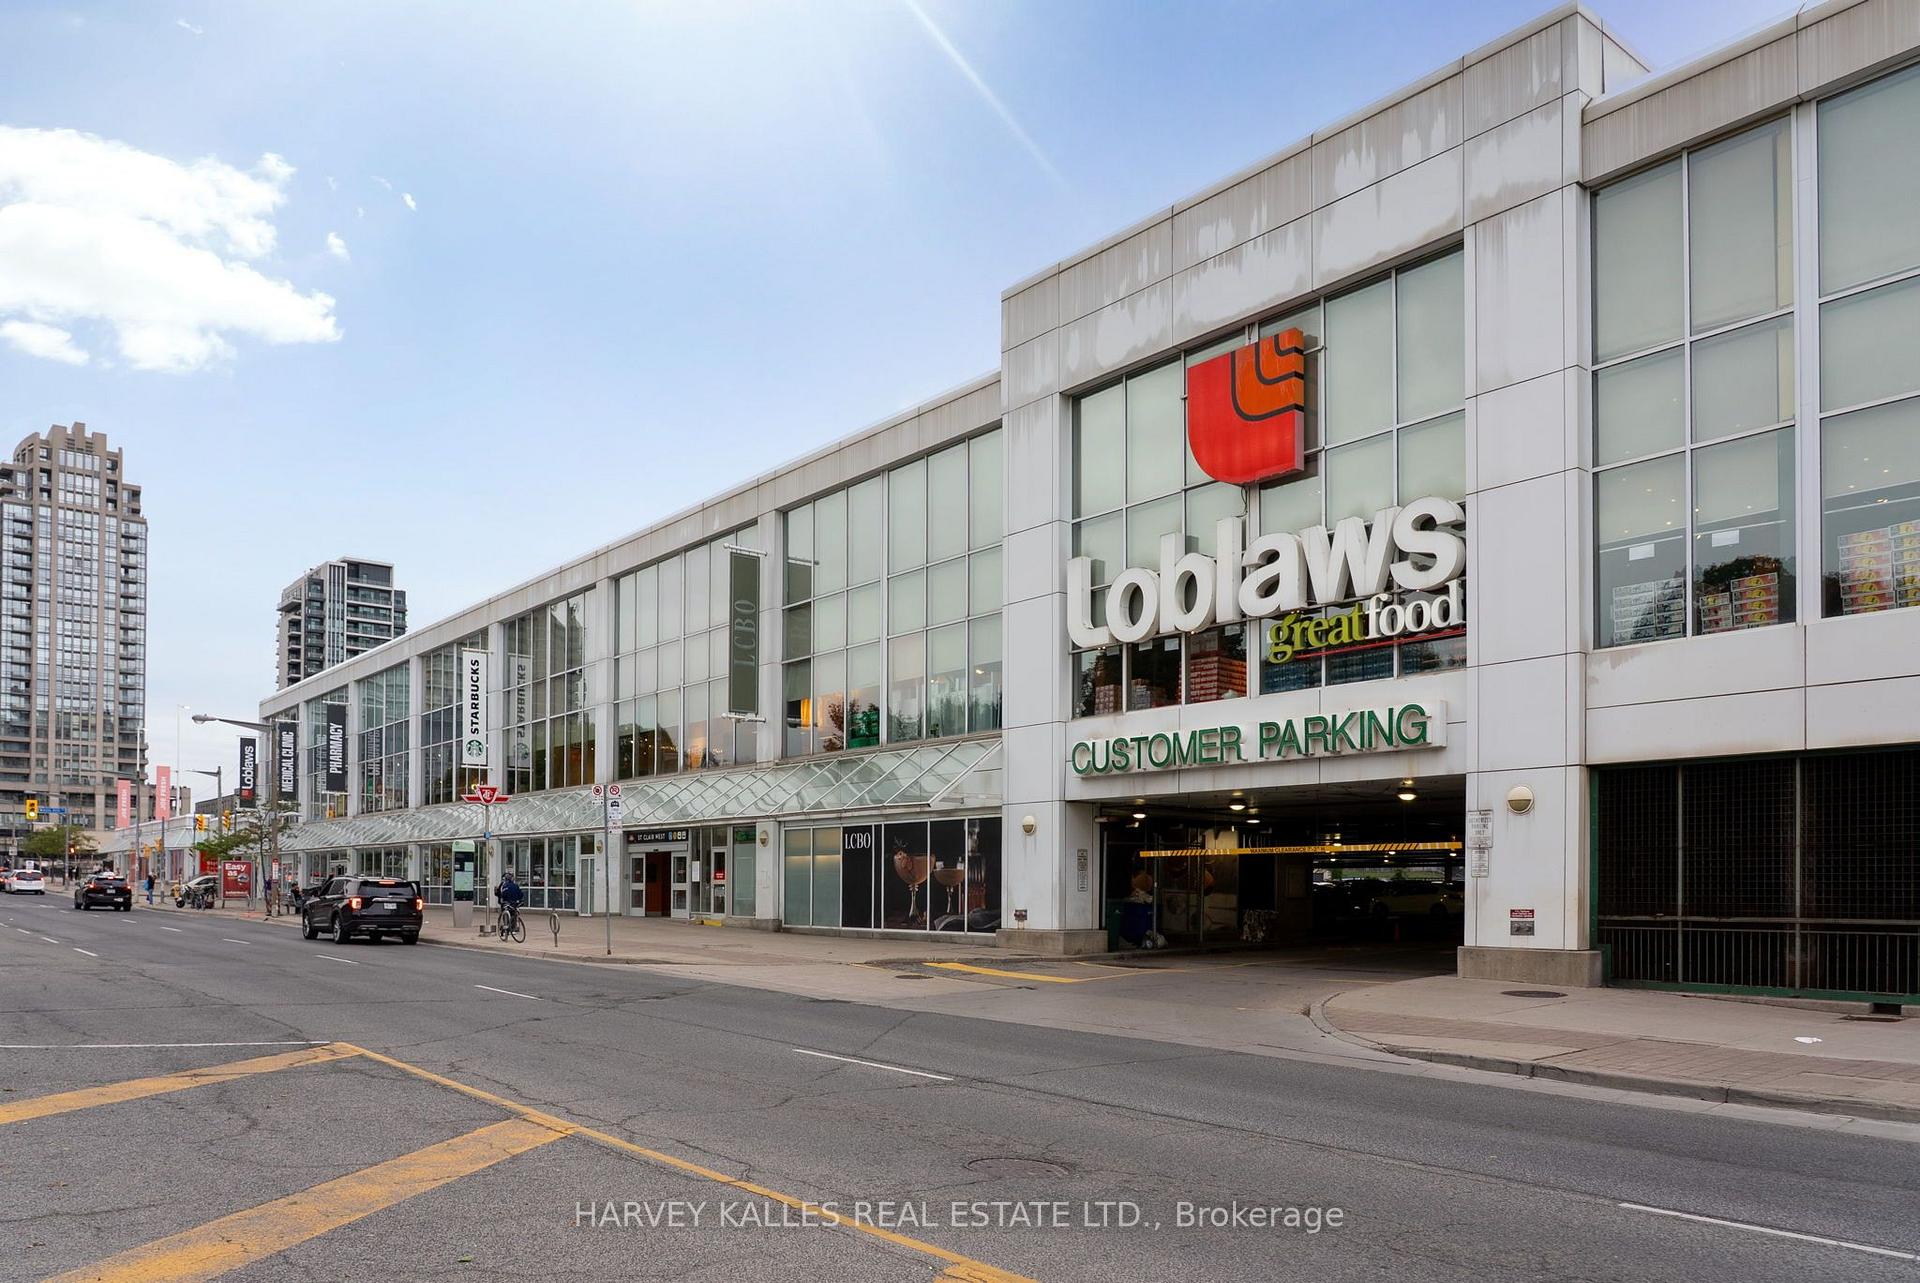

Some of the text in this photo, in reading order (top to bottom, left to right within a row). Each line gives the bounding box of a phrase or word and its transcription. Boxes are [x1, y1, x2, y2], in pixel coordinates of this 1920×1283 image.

[1066, 497, 1466, 648] Loblaws
[734, 599, 755, 667] LCBO
[471, 658, 479, 735] STARBUCKS
[242, 745, 254, 789] Loblaws
[281, 731, 295, 792] MEDICAL CLINIC
[329, 722, 343, 774] PHARMACY
[1071, 703, 1429, 775] CUSTOMER PARKING
[225, 863, 246, 871] Easy
[845, 832, 871, 849] LCBO
